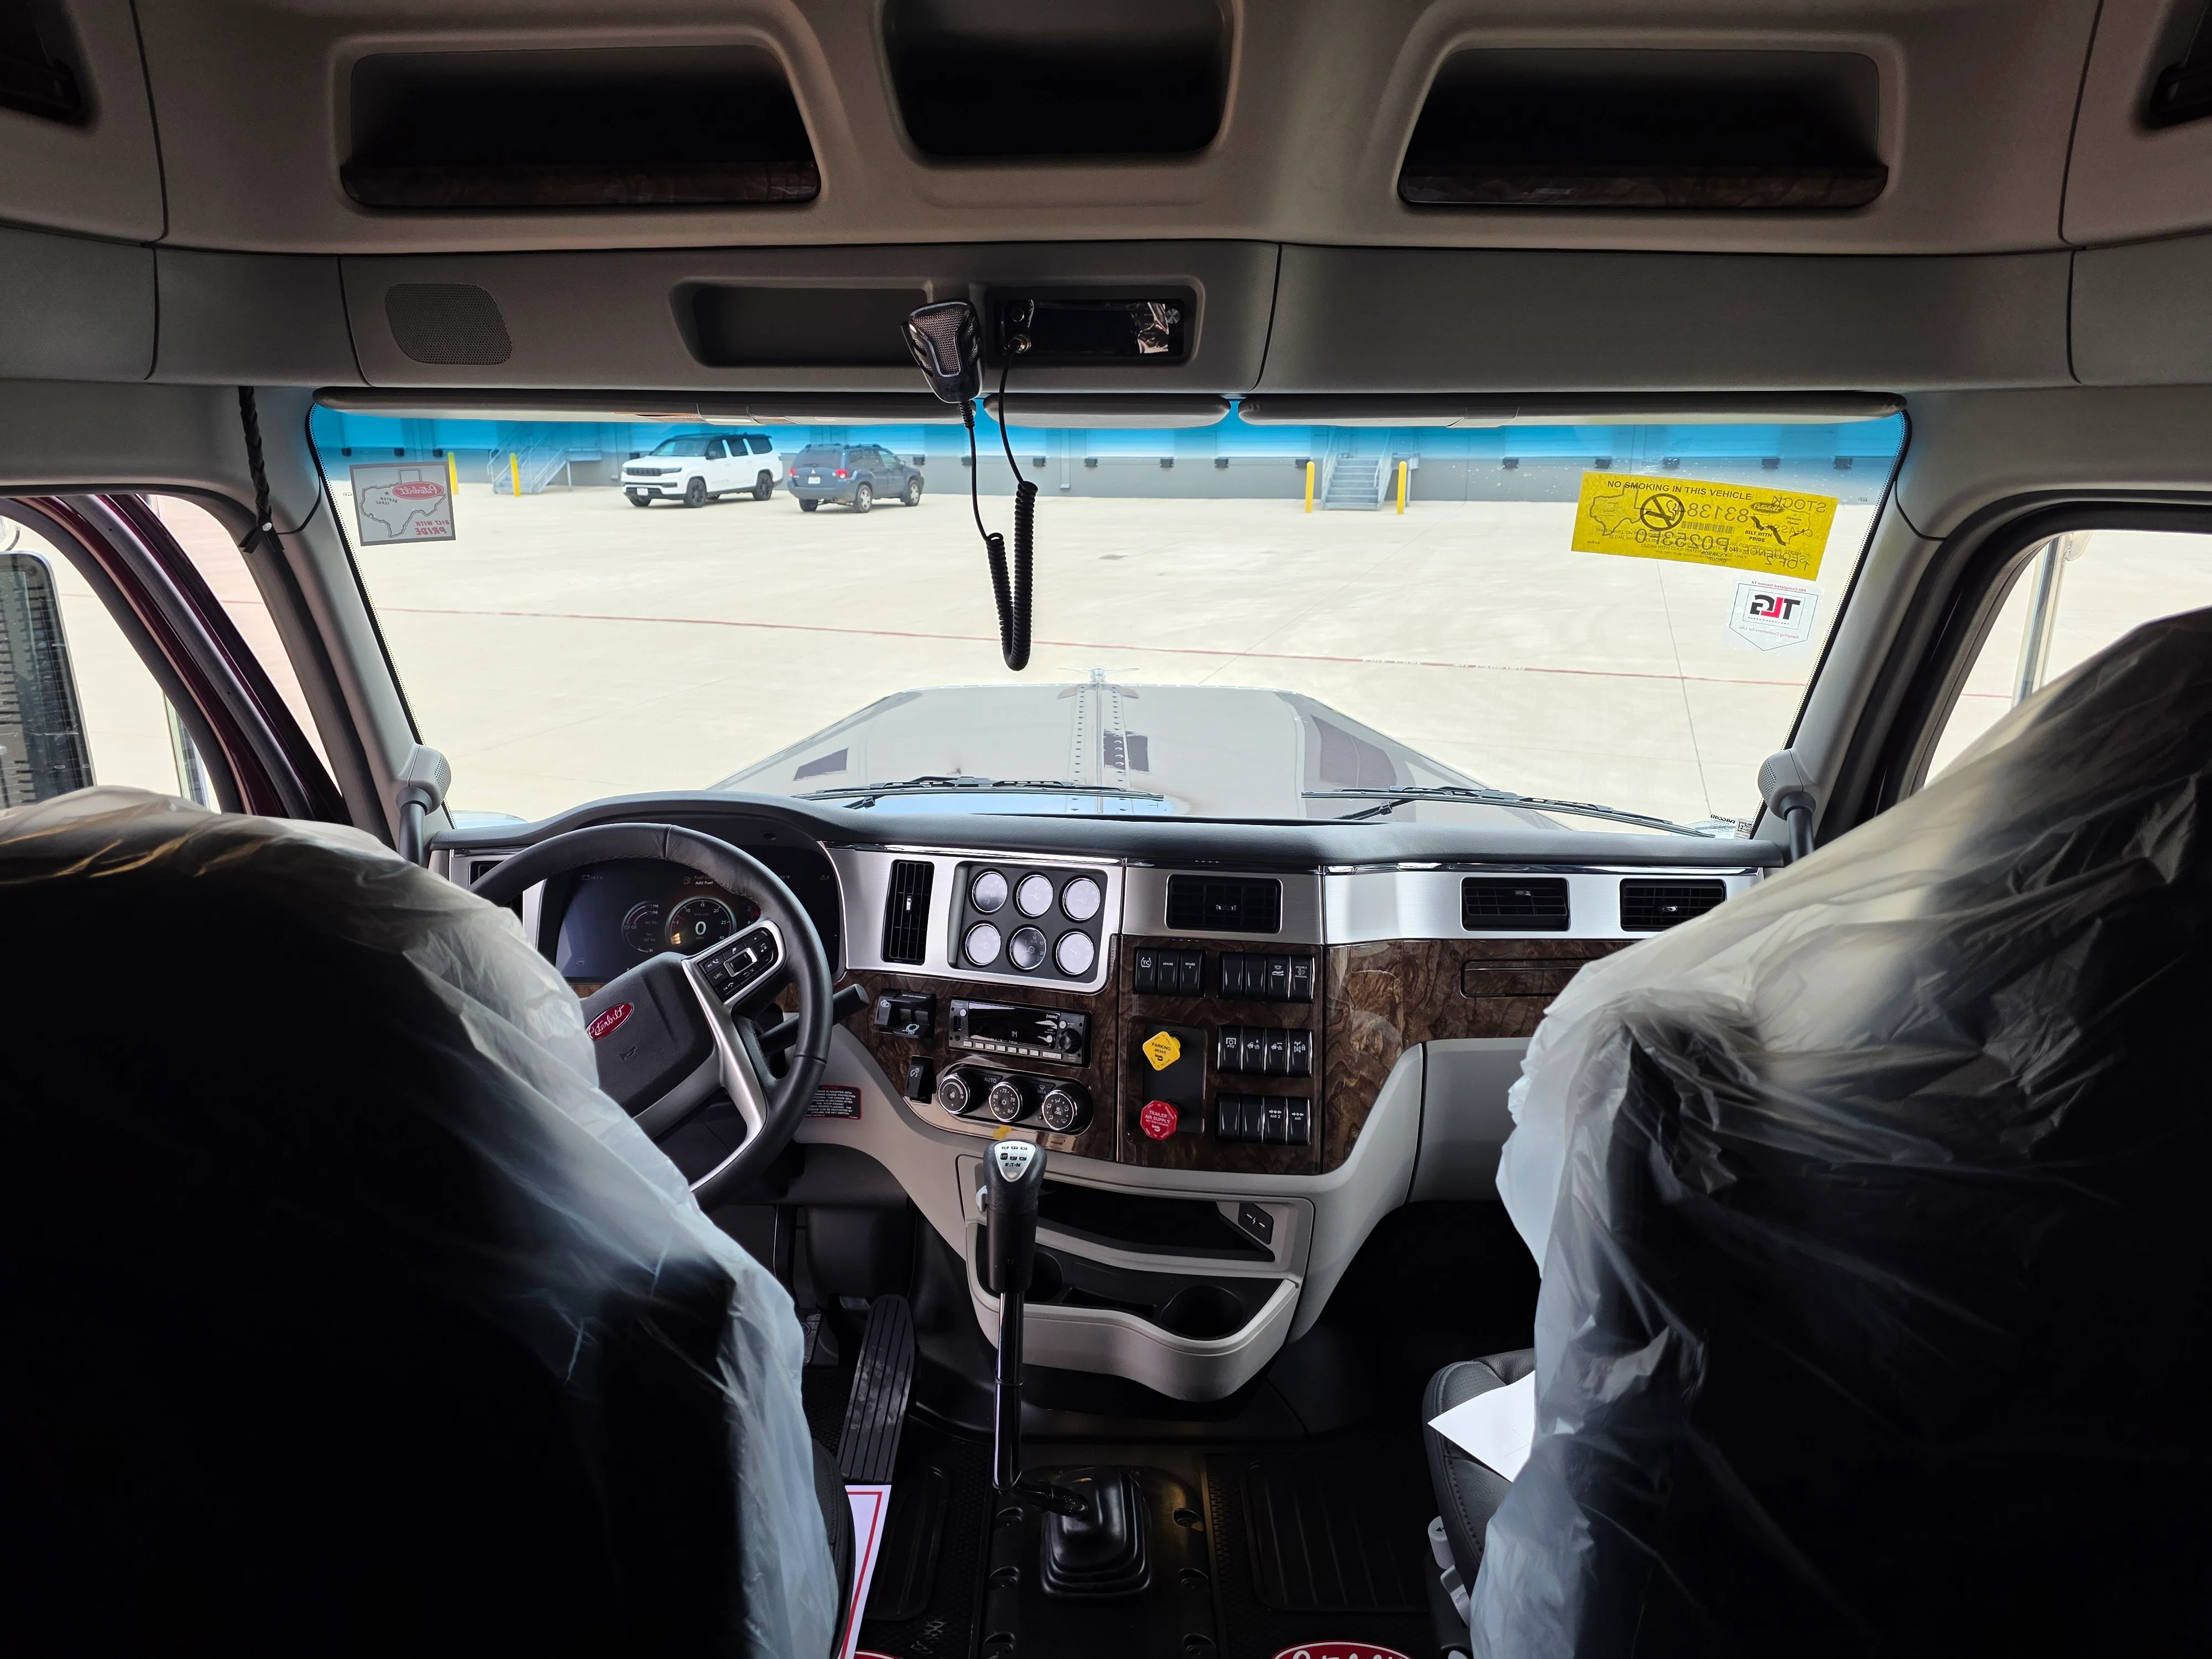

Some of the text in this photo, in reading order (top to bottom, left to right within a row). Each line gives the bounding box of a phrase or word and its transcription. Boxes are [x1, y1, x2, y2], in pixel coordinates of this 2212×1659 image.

[1624, 481, 1670, 492] SMOKING
[1685, 487, 1707, 495] THIS
[1709, 489, 1752, 500] VEHICLE
[1753, 503, 1782, 513] Peterbilt
[695, 921, 707, 935] 0
[589, 1004, 625, 1039] Peterbilt
[1151, 1042, 1171, 1051] PARKING
[1149, 1110, 1167, 1118] TRAILER
